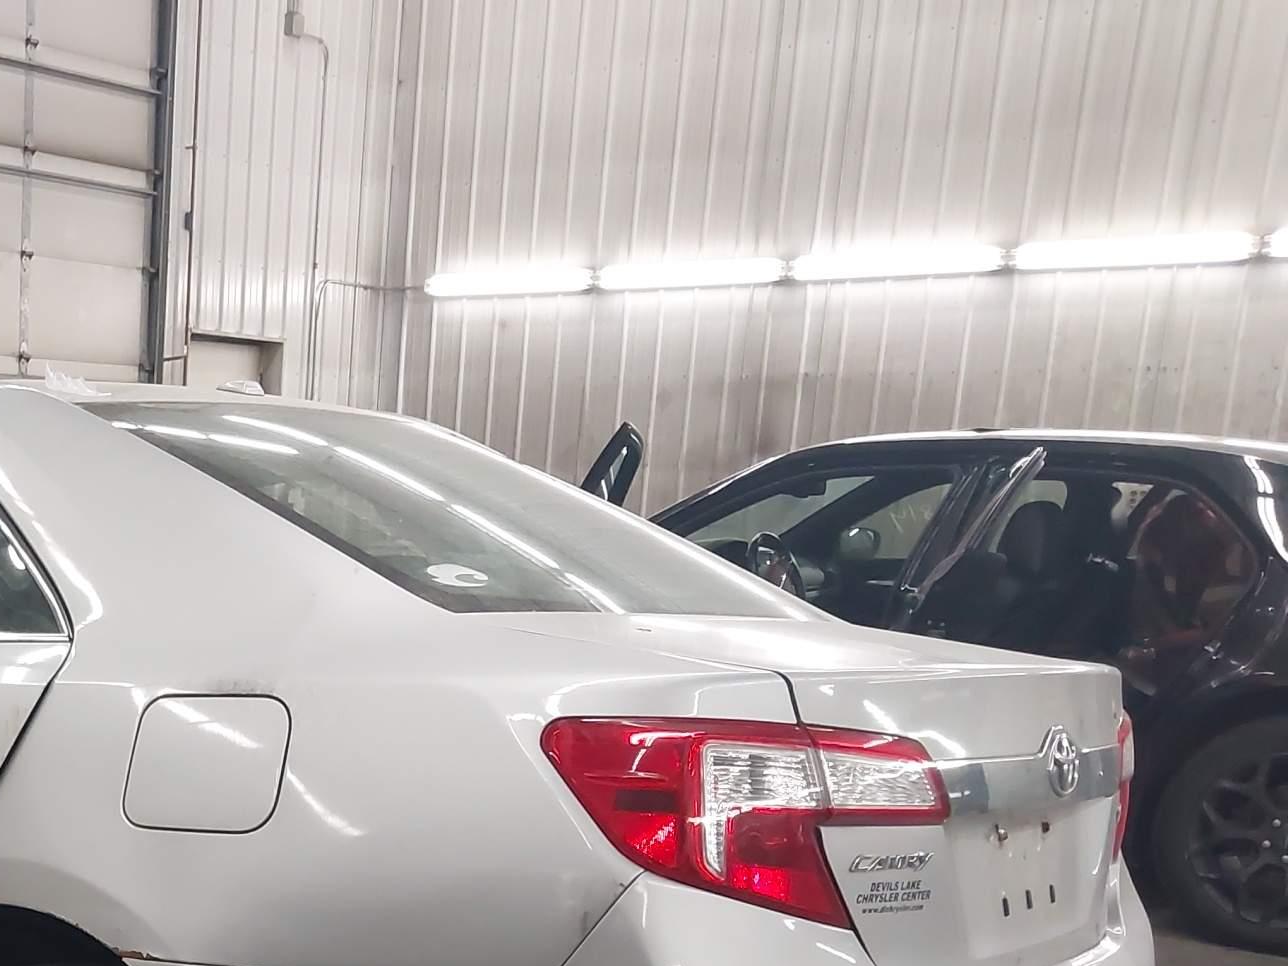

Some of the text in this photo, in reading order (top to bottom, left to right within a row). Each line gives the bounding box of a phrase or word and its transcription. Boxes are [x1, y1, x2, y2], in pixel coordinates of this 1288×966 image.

[870, 880, 923, 892] DEVILS LAKE
[856, 890, 931, 904] CHRYSLER CENTER
